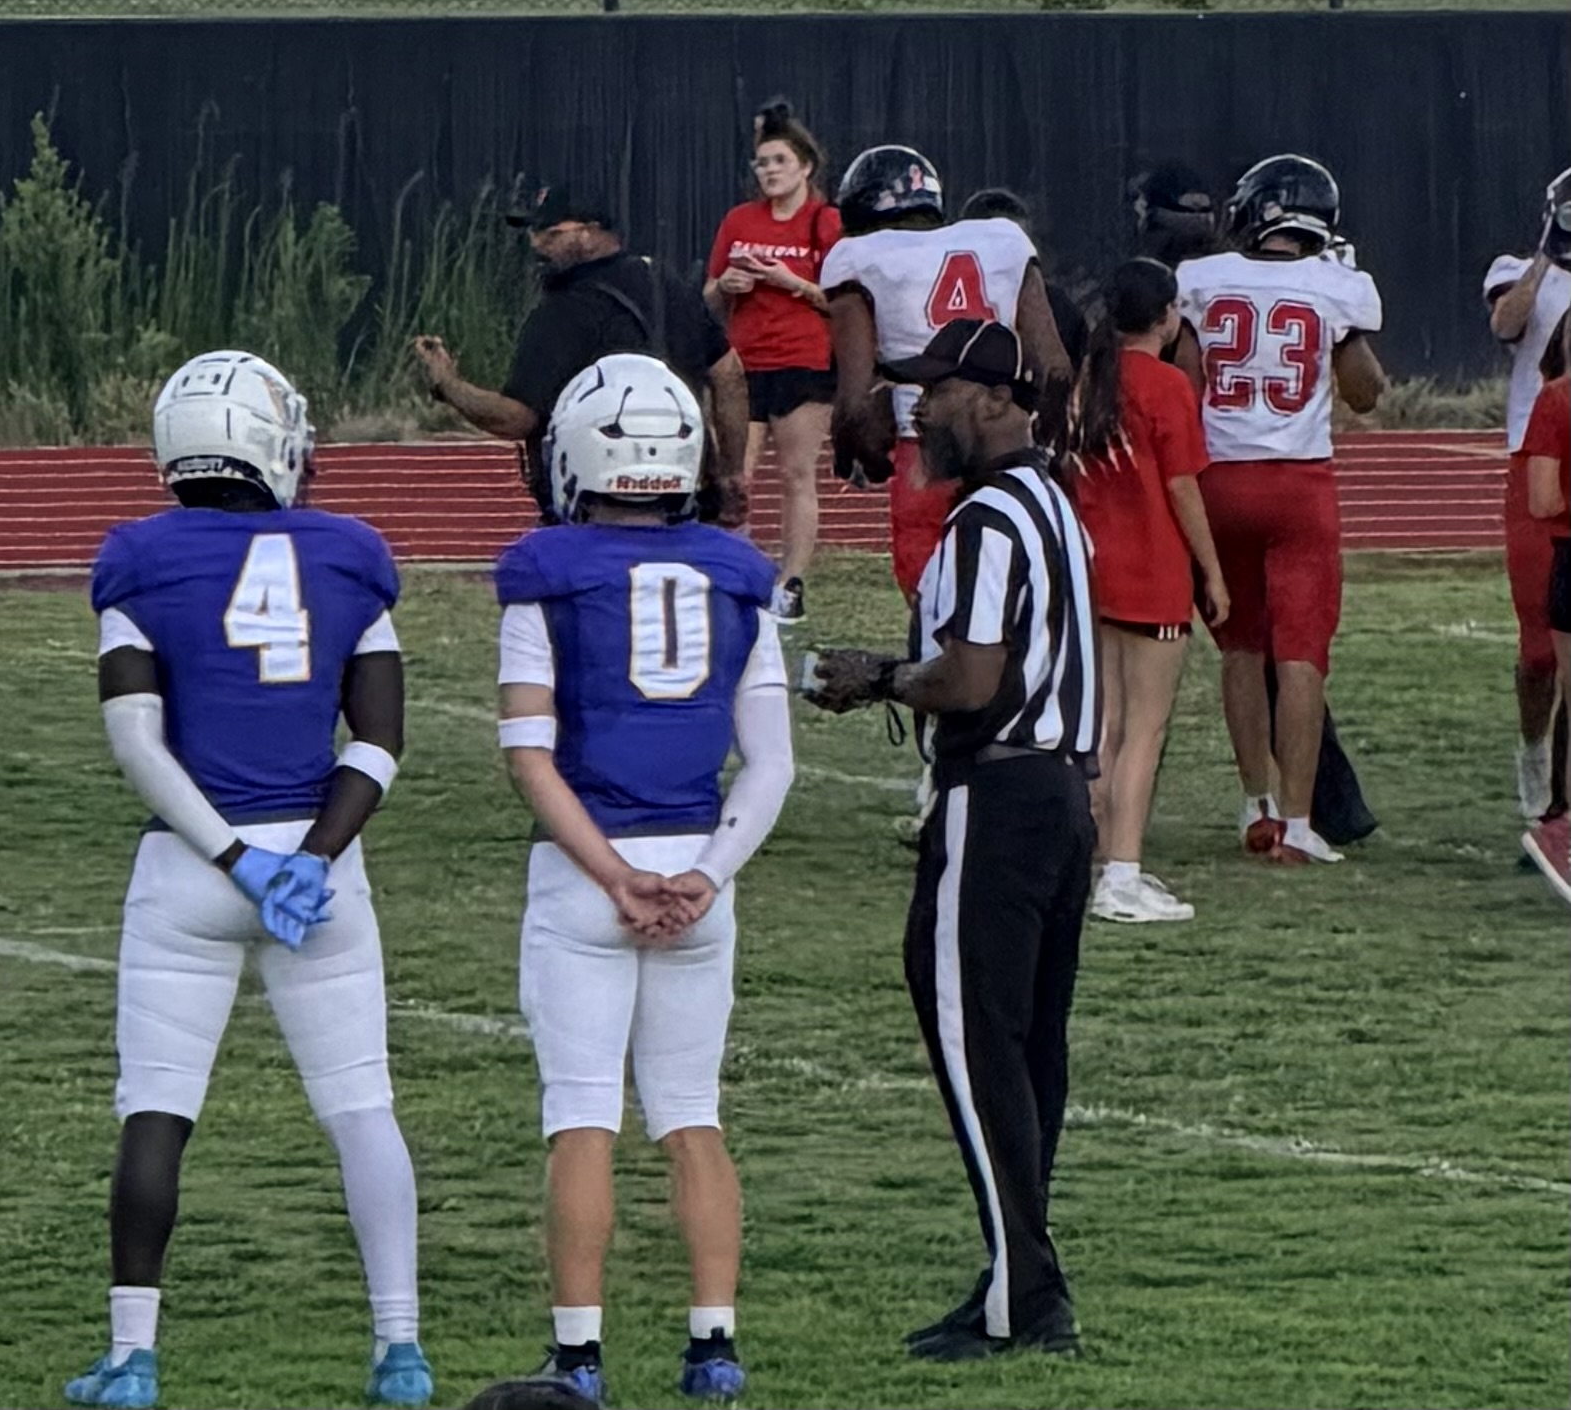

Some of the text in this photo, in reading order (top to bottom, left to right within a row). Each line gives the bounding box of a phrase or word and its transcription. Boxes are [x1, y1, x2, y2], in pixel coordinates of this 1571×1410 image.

[1202, 294, 1325, 417] 23
[223, 533, 312, 684] 4
[628, 562, 711, 700] 0
